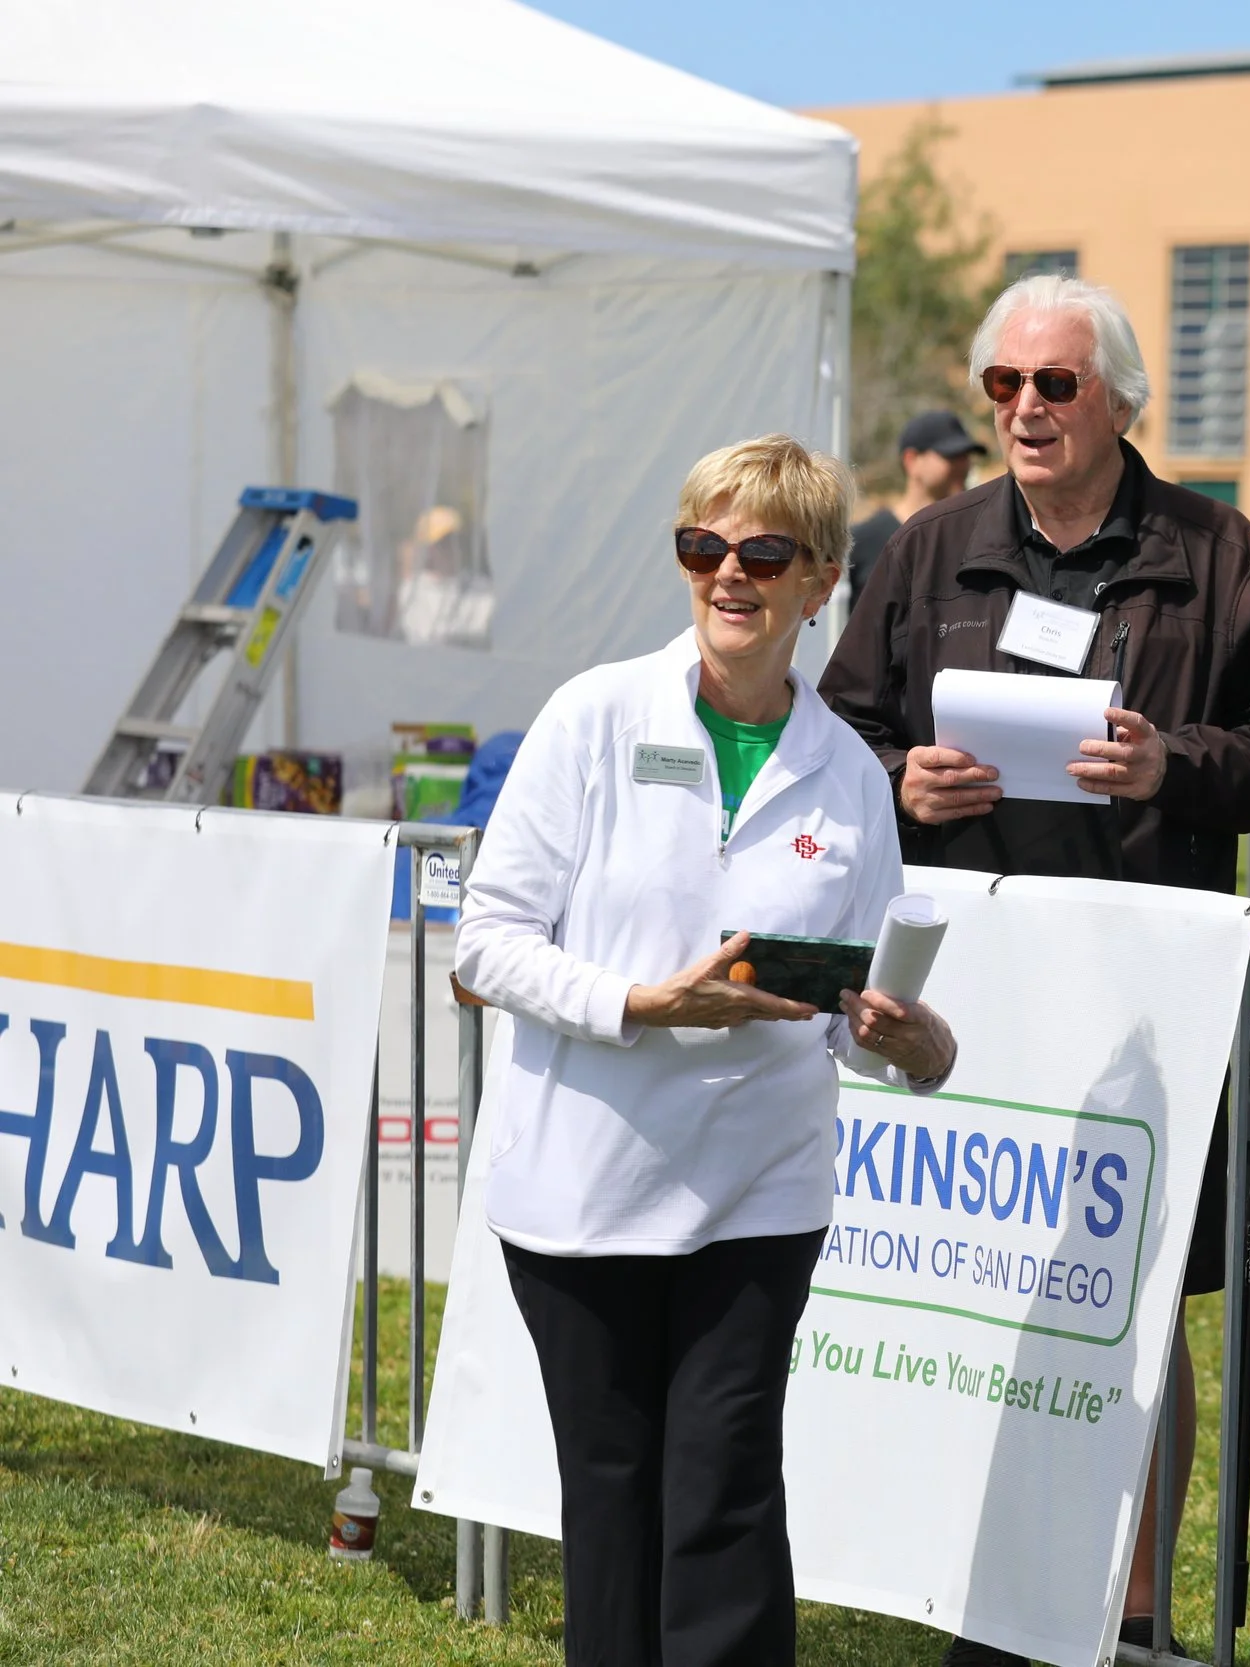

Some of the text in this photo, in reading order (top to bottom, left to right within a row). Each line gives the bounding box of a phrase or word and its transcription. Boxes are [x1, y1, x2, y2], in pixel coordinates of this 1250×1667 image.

[1041, 625, 1062, 637] Chris
[429, 861, 460, 880] United
[0, 1012, 325, 1286] HARP
[931, 1238, 969, 1280] OF
[972, 1245, 1012, 1291] SAN
[1017, 1254, 1113, 1309] DIEGO
[812, 1330, 864, 1375] You
[872, 1341, 937, 1387] Live
[947, 1351, 985, 1398] Your
[986, 1363, 1046, 1413] Best
[1048, 1376, 1123, 1424] Life”
